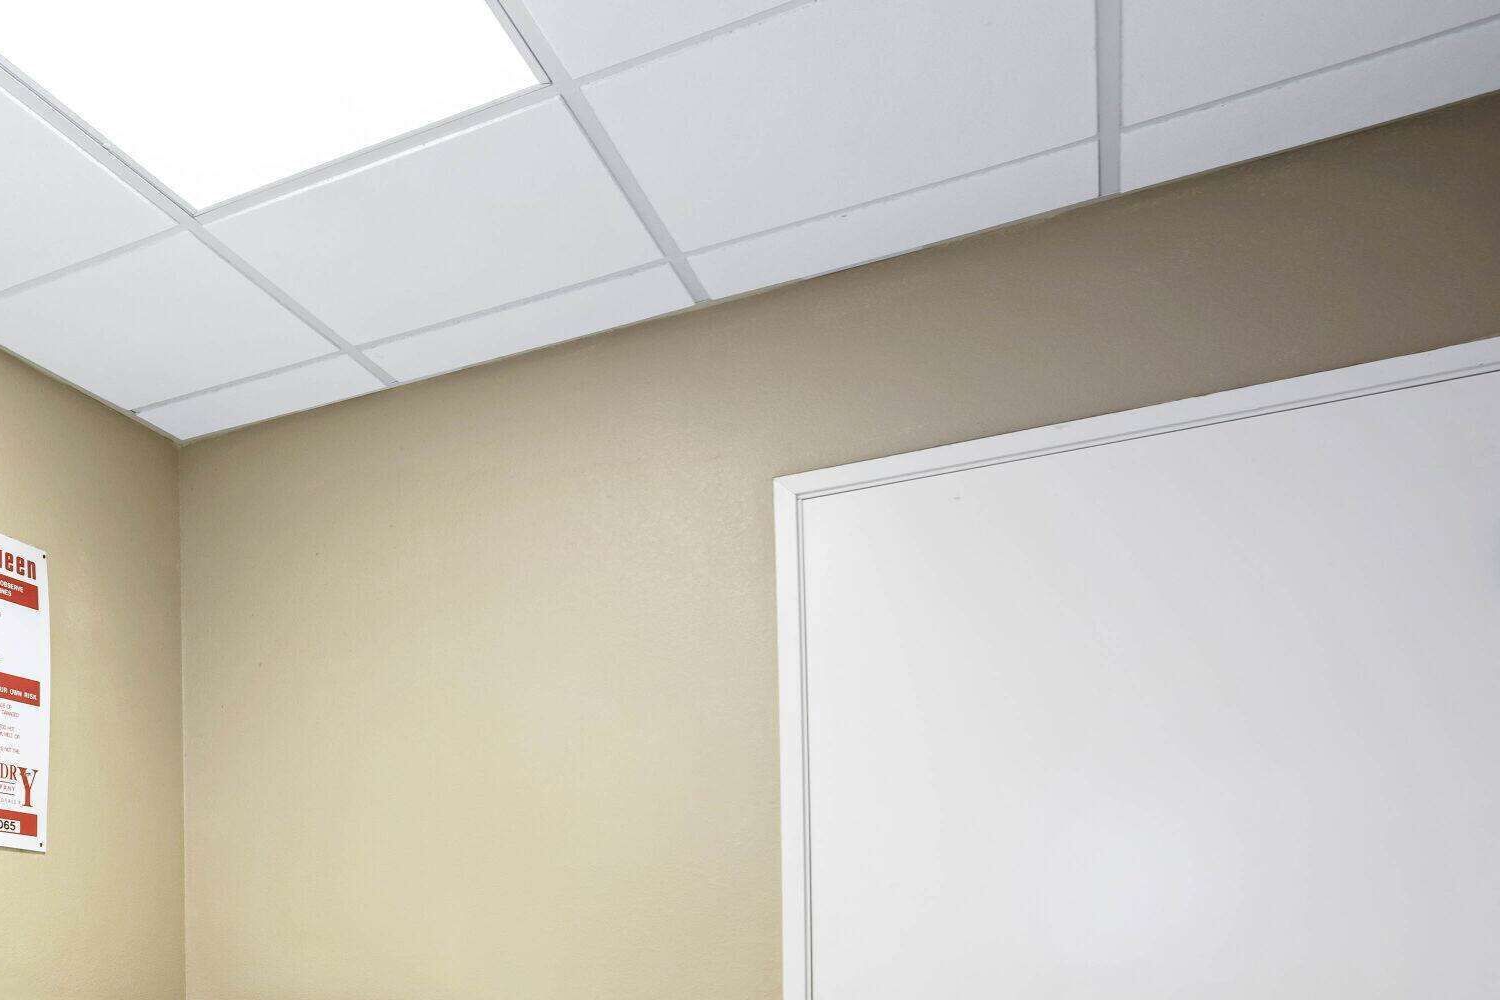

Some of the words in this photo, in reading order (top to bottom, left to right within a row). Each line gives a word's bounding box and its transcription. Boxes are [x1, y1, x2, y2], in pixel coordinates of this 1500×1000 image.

[0, 579, 24, 592] OBSERVE
[9, 688, 22, 697] OWN
[24, 692, 37, 701] RISK
